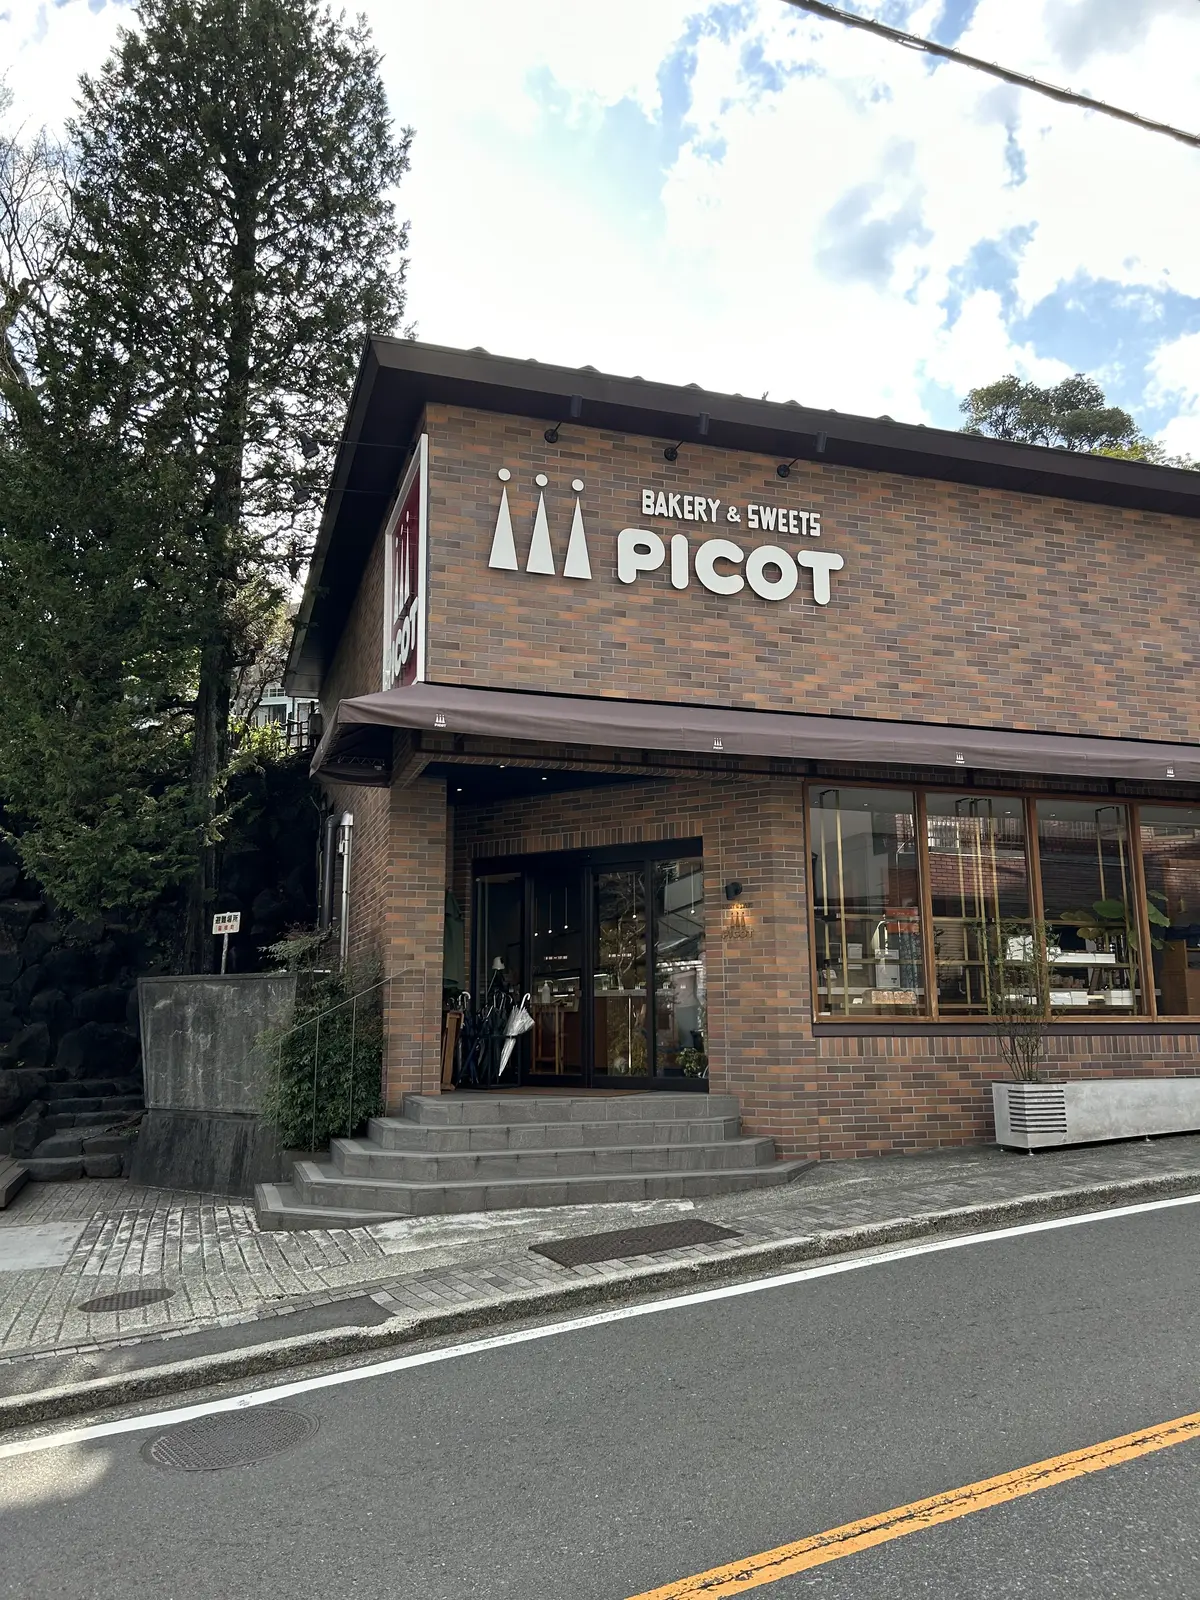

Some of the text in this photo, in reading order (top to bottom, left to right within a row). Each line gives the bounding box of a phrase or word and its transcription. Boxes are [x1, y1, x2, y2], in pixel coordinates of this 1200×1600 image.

[642, 489, 821, 537] BAKERY & SWEETS
[617, 528, 844, 605] PICOT
